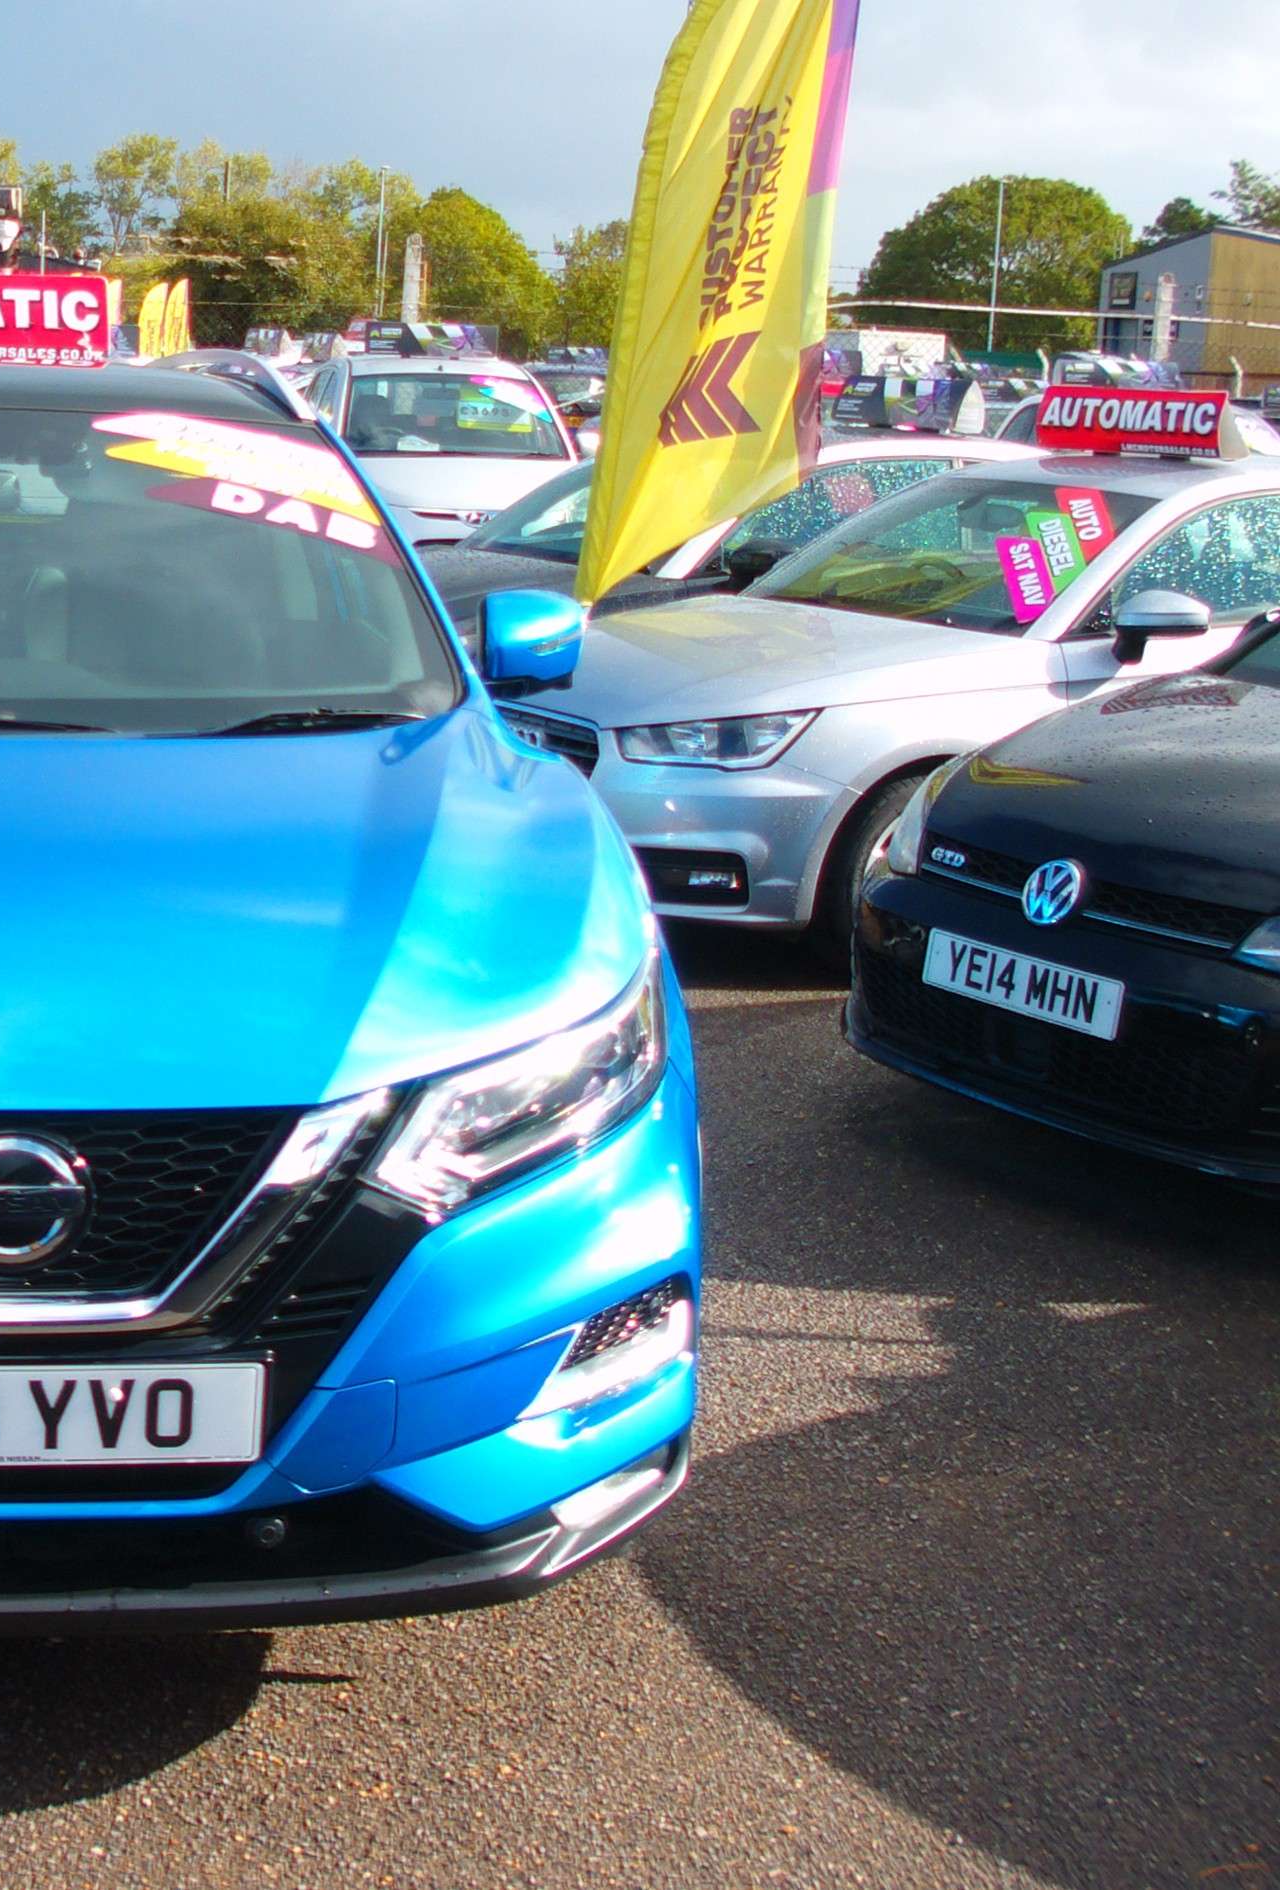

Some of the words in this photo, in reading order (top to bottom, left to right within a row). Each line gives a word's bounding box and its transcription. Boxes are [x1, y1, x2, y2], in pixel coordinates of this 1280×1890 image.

[1040, 396, 1217, 435] AUTOMATIC
[211, 480, 377, 549] DAB
[1068, 498, 1102, 540] AUTO
[1009, 542, 1036, 571] SAT
[1039, 517, 1075, 577] DIESEL
[1017, 572, 1046, 606] NAV
[931, 847, 966, 868] GTD
[950, 940, 1017, 1000] YE14
[1024, 964, 1099, 1024] MHN
[28, 1378, 195, 1450] YVO
